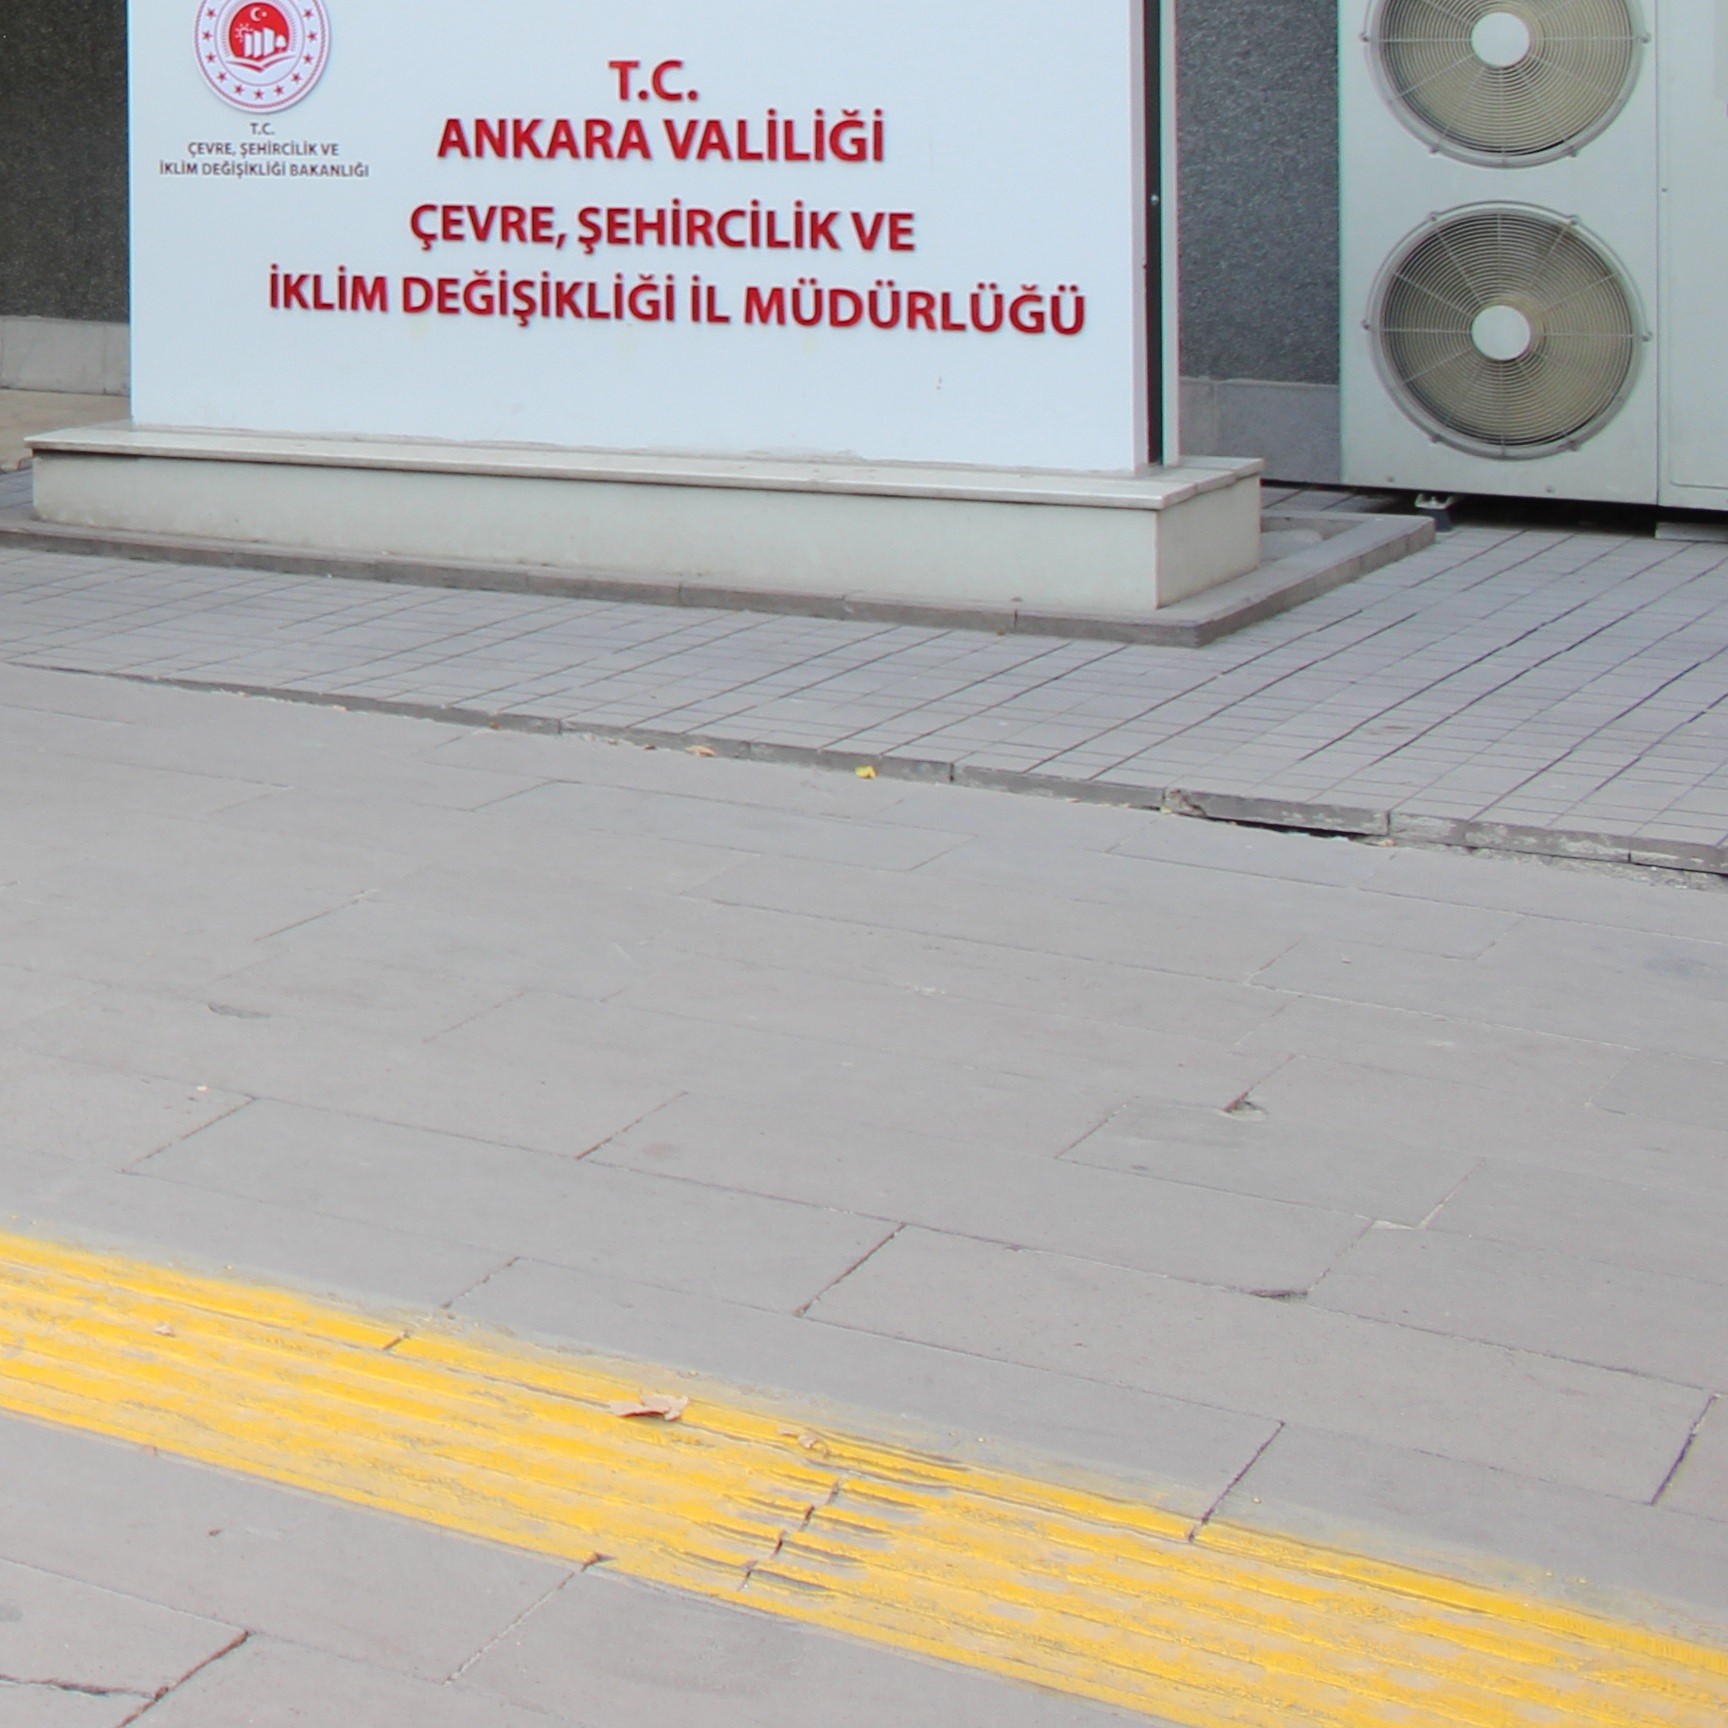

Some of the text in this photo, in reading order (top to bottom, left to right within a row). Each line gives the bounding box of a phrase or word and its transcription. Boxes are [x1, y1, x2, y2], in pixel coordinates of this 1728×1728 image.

[608, 59, 698, 103] T.C.
[187, 140, 340, 158] ÇEVRE, ŞEHİRCİLİK VE
[250, 122, 275, 136] T.C.
[436, 108, 886, 164] ANKARA VALİLİĞİ
[159, 159, 369, 179] İKLİM DEĞİŞİKLİĞİ BAKANLIĞI
[408, 198, 916, 256] ÇEVRE, ŞEHİRCİLİK VE
[268, 265, 1086, 336] İKLİM DEĞİŞİKLİĞİ İL MÜDÜRLÜĞÜ
